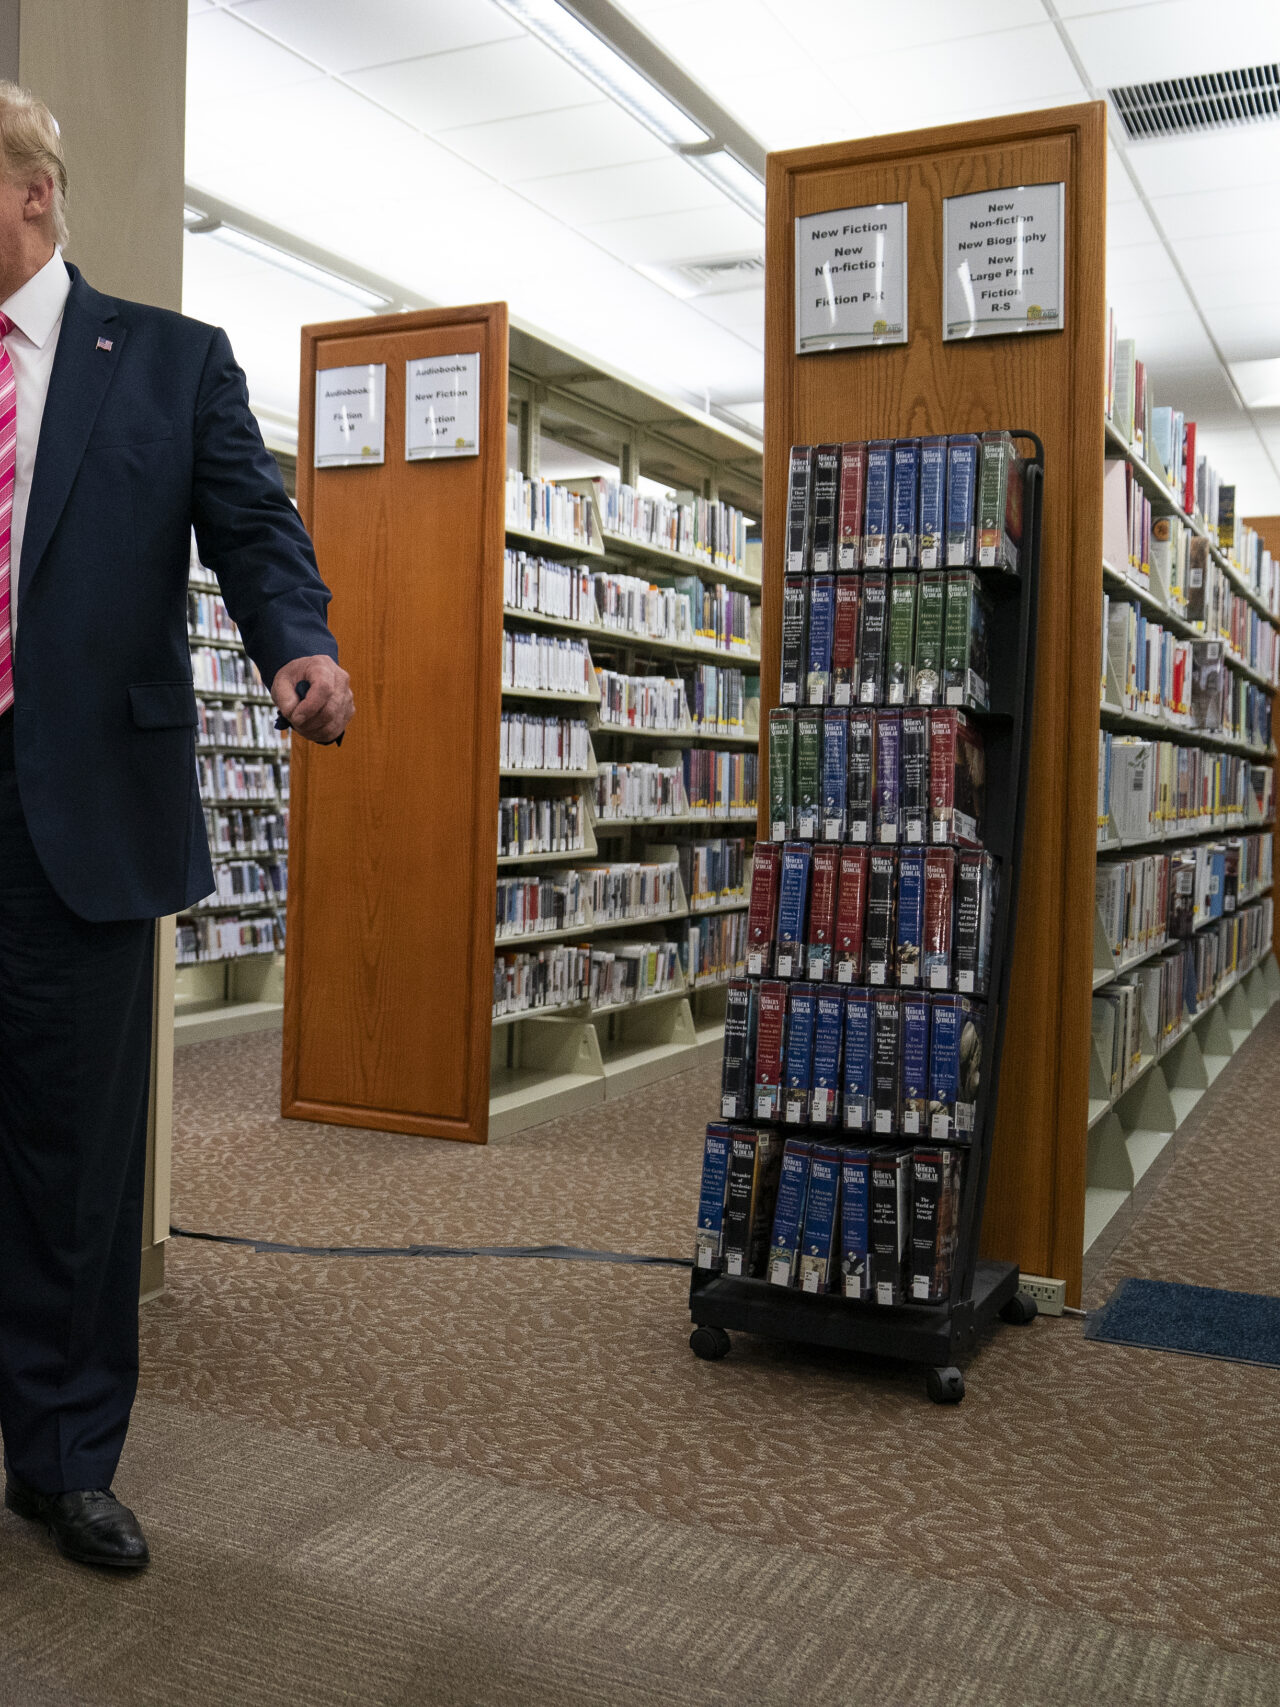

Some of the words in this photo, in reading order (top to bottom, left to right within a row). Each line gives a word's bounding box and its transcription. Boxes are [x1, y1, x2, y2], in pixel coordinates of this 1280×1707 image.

[988, 203, 1014, 213] New
[970, 215, 1034, 230] Non-fiction
[812, 229, 839, 240] New
[842, 222, 888, 235] Fiction
[958, 240, 983, 251] New
[986, 233, 1047, 246] Biogrphy
[834, 246, 863, 257] New
[988, 256, 1014, 265] New
[815, 260, 884, 276] Nn-fictio
[969, 269, 1001, 282] Large
[1005, 267, 1034, 277] Prnt
[991, 302, 1011, 312] R-S
[416, 365, 467, 376] Audiobooks
[415, 393, 433, 401] New
[436, 390, 468, 399] Fiction
[340, 424, 355, 432] LM
